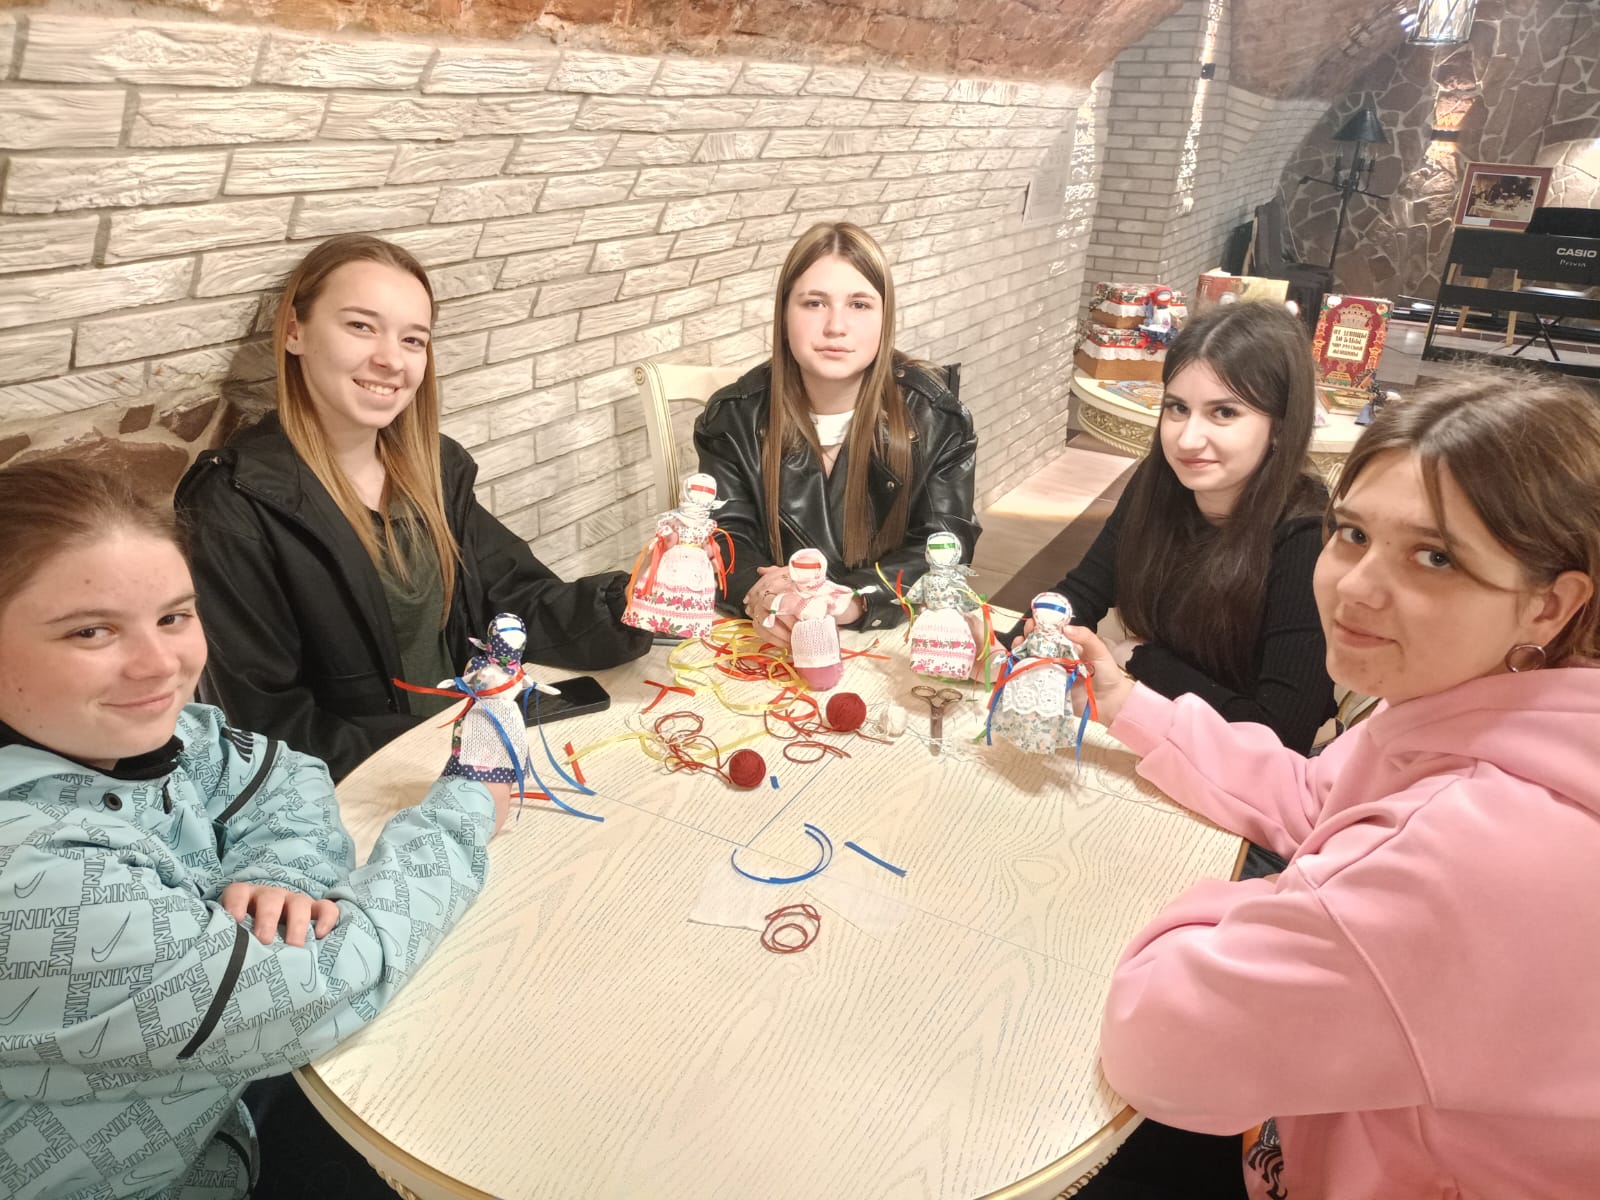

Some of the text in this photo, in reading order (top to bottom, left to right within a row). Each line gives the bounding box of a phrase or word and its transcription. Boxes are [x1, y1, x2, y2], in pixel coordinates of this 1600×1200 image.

[1556, 247, 1597, 258] CASIO
[80, 883, 134, 906] NIKE
[14, 906, 80, 931] NIKE
[150, 899, 174, 944] NIKE
[47, 927, 77, 977] NIKE
[236, 954, 281, 992] NIKE
[65, 971, 93, 1017] NIKE
[93, 963, 154, 988] NIKE
[154, 962, 208, 1001] NIKE
[266, 972, 294, 1018] NIKE
[133, 989, 162, 1034] NIKE
[144, 1021, 201, 1051] NIKE
[33, 1112, 79, 1159] NIKE
[99, 1099, 149, 1144] NIKE
[137, 1110, 172, 1150] NIKE
[3, 1146, 59, 1193] NIKE
